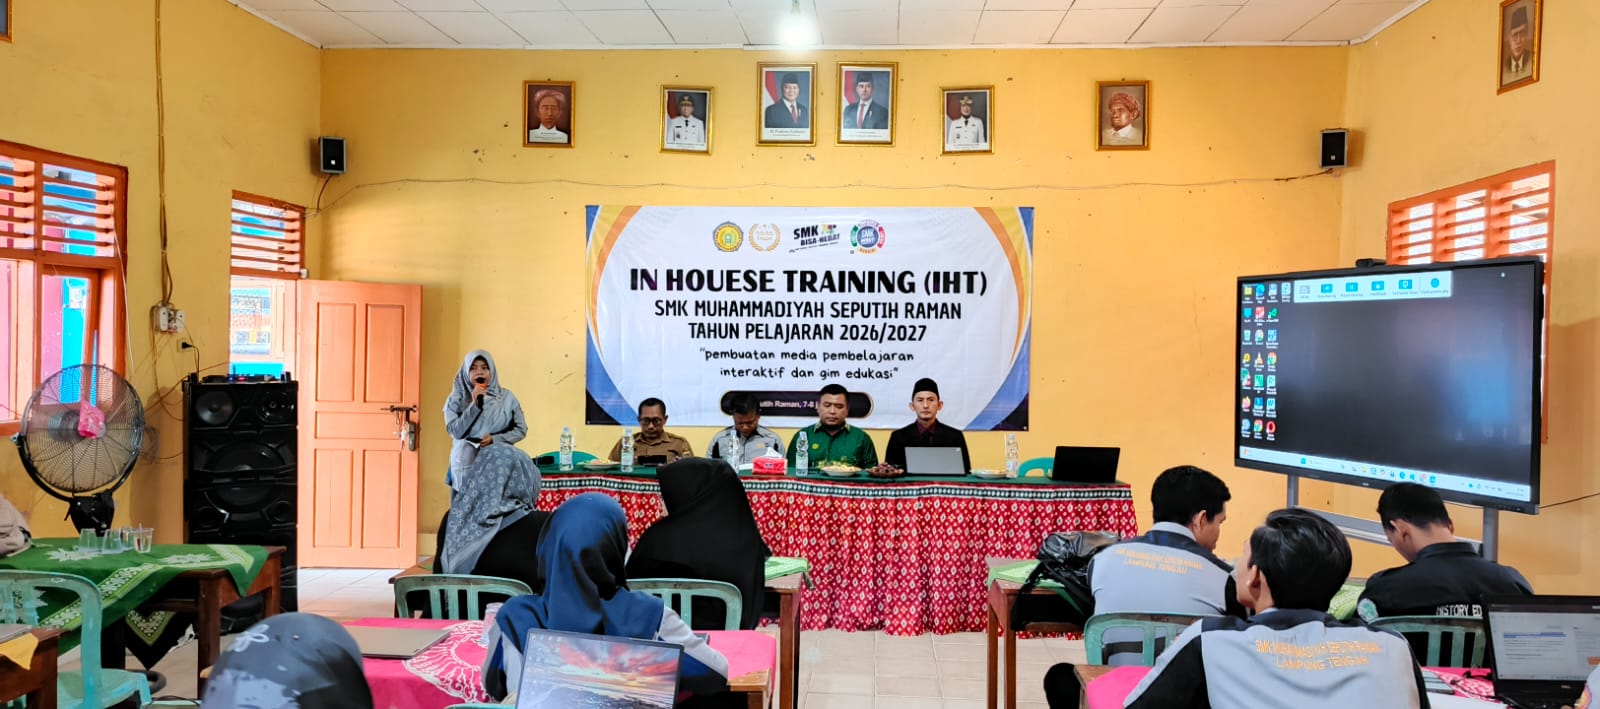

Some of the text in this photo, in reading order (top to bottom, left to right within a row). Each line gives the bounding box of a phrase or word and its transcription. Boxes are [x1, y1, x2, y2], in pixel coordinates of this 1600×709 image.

[793, 224, 819, 240] SMK
[630, 268, 987, 297] IN HOUESE TRAINING (IHT)
[654, 299, 962, 320] SMK MUHAMMADIYAH SEPUTIH RAMAN
[687, 322, 927, 345] TAHUN PELAJARAN 2026/2027
[780, 348, 817, 361] media
[822, 349, 914, 364] pembelajaran
[720, 366, 899, 381] interaktif dan gim edukasi"
[1436, 603, 1469, 617] HISTORY
